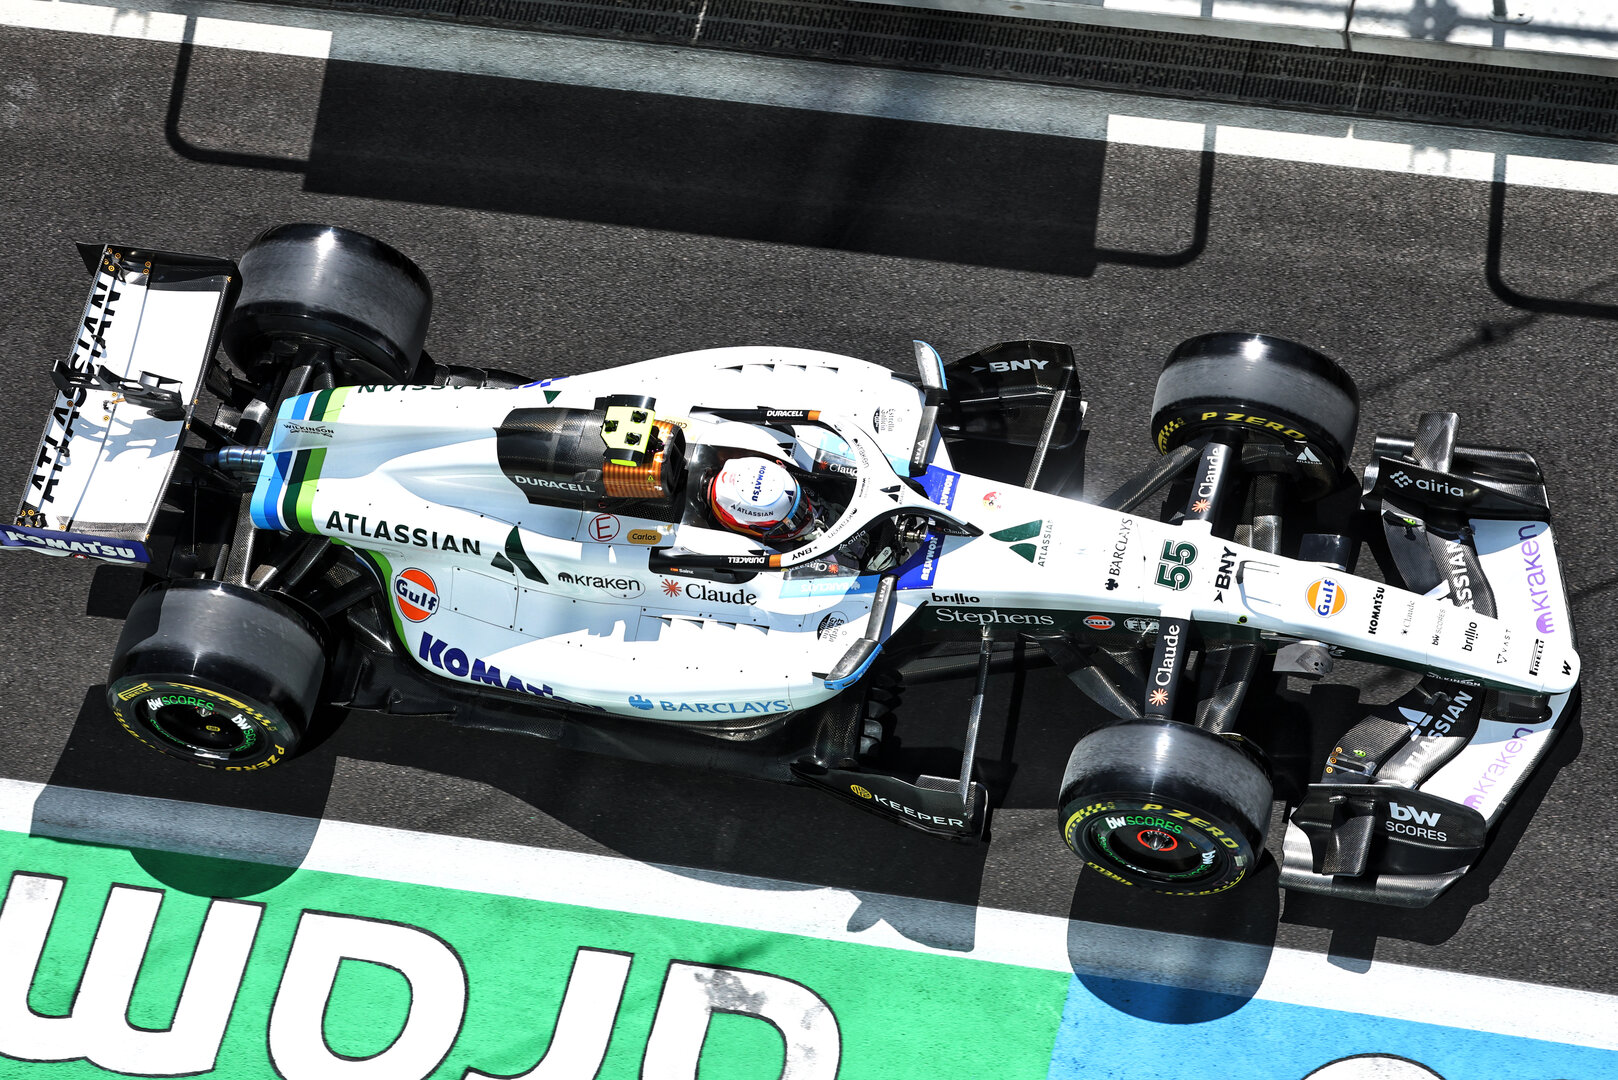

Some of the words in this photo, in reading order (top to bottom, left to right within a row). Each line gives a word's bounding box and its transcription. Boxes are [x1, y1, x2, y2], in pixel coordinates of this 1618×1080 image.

[989, 358, 1049, 374] BNY
[767, 410, 804, 418] DURACELL
[1201, 411, 1218, 421] P
[1224, 412, 1307, 439] ZERO
[283, 422, 335, 435] WILKINSON
[514, 474, 596, 494] DURACELL
[751, 465, 767, 502] KOMATSU
[1198, 447, 1222, 499] Claude
[1415, 478, 1464, 498] airia
[737, 507, 774, 518] ATLASSIAN
[5, 530, 136, 559] KOMATSU
[326, 510, 481, 556] ATLASSIAN
[632, 533, 657, 541] Carlos
[791, 547, 813, 560] BNY
[1109, 518, 1134, 577] BARCLAYS
[728, 556, 765, 564] DURACELL
[1154, 539, 1198, 591] 55
[1214, 546, 1237, 590] BNY
[1518, 524, 1551, 612] kraken
[574, 573, 641, 592] kraken
[685, 582, 758, 606] Claude
[395, 579, 437, 612] Gulf
[932, 592, 982, 605] brillio
[1317, 578, 1335, 616] Gulf
[935, 607, 1056, 627] Stephens
[1368, 586, 1385, 635] KOMATSU
[1461, 621, 1479, 652] brillio
[1501, 628, 1512, 653] VAST
[1155, 624, 1181, 687] Claude
[1528, 638, 1545, 677] PIRELLI
[1561, 659, 1572, 676] W
[161, 695, 215, 711] SCORES
[660, 700, 789, 714] BARCLAYS
[274, 743, 285, 755] P
[1473, 727, 1534, 795] kraken
[873, 793, 965, 828] KEEPER
[1125, 815, 1184, 835] SCORES
[1141, 803, 1164, 811] P
[1167, 809, 1239, 849] ZERO
[1384, 820, 1448, 843] SCORES
